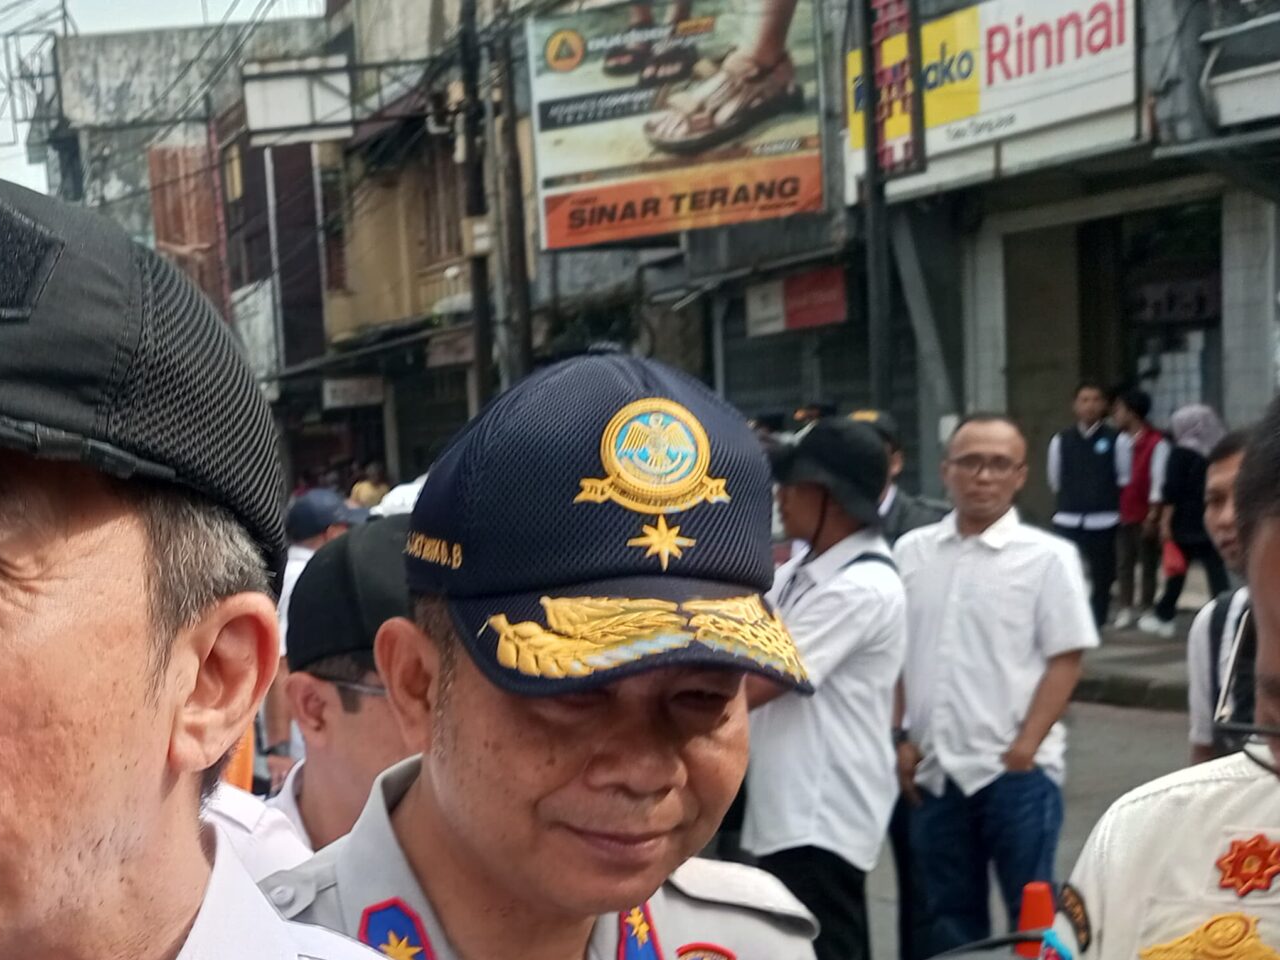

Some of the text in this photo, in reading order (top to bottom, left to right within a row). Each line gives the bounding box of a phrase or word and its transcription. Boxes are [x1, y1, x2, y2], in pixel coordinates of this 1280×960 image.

[985, 0, 1126, 87] Rinnai
[568, 176, 801, 230] SINAR TERANG
